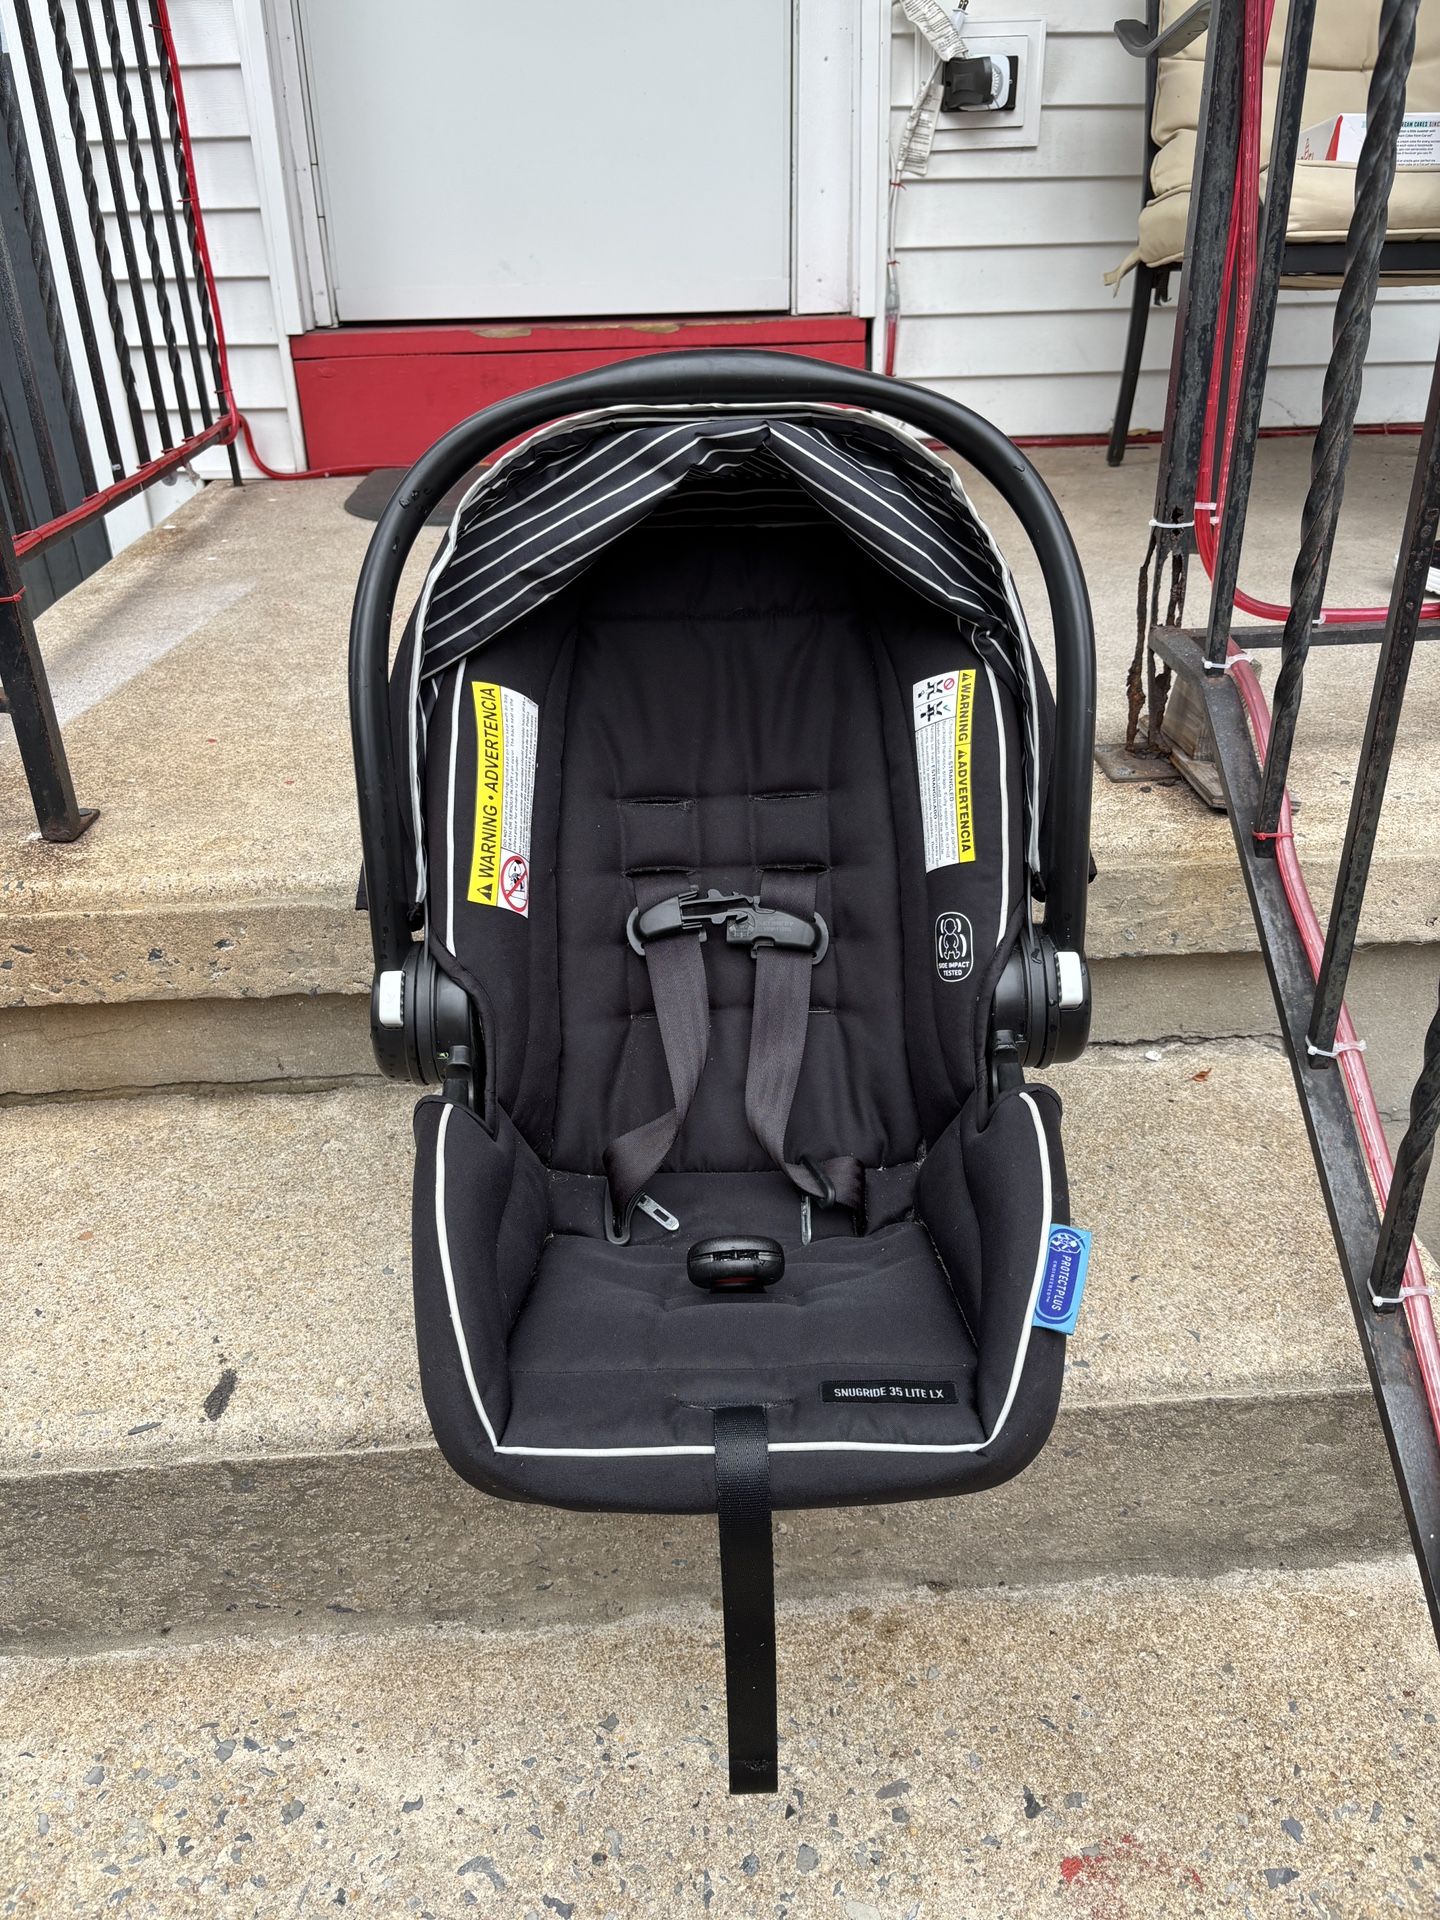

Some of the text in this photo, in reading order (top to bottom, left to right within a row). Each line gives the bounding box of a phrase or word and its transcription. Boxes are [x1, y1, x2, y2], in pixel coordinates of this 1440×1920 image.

[958, 683, 971, 742] WARNING
[478, 688, 499, 879] WARNING ADVERTENCIA
[957, 761, 971, 853] ADVERTENCIA
[1052, 1255, 1071, 1311] PROTECTPLUS
[834, 1387, 944, 1399] SNUGRIDE 35 LITE LX
